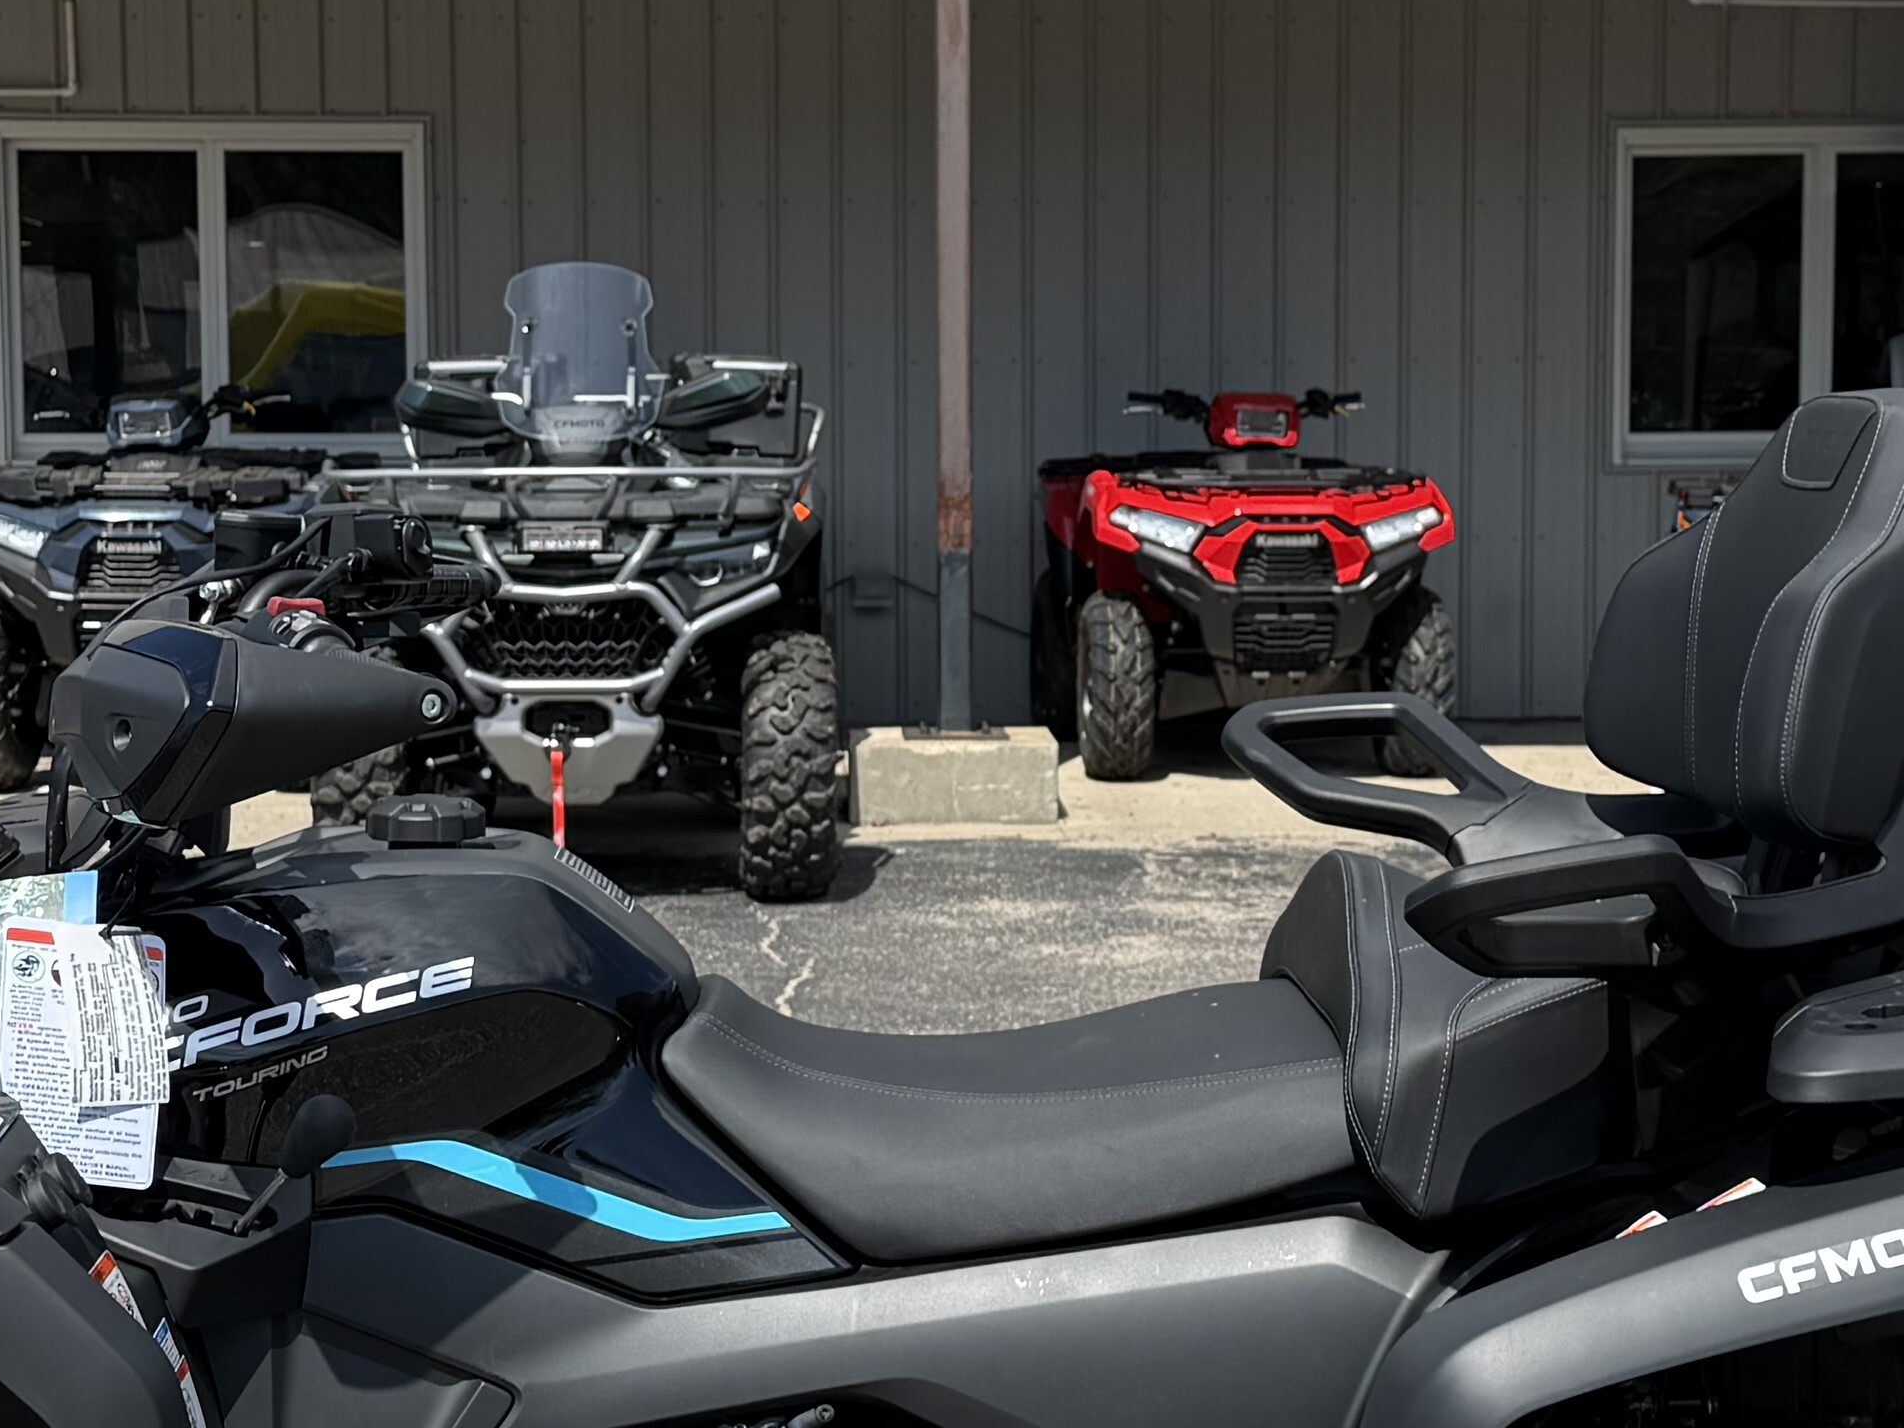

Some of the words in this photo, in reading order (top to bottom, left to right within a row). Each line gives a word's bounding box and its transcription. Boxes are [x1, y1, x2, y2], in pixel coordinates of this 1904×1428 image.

[554, 419, 606, 429] CFMOTO
[96, 538, 162, 554] Kawasaki
[1255, 533, 1319, 549] Kawasaki
[192, 1044, 329, 1103] TOURING
